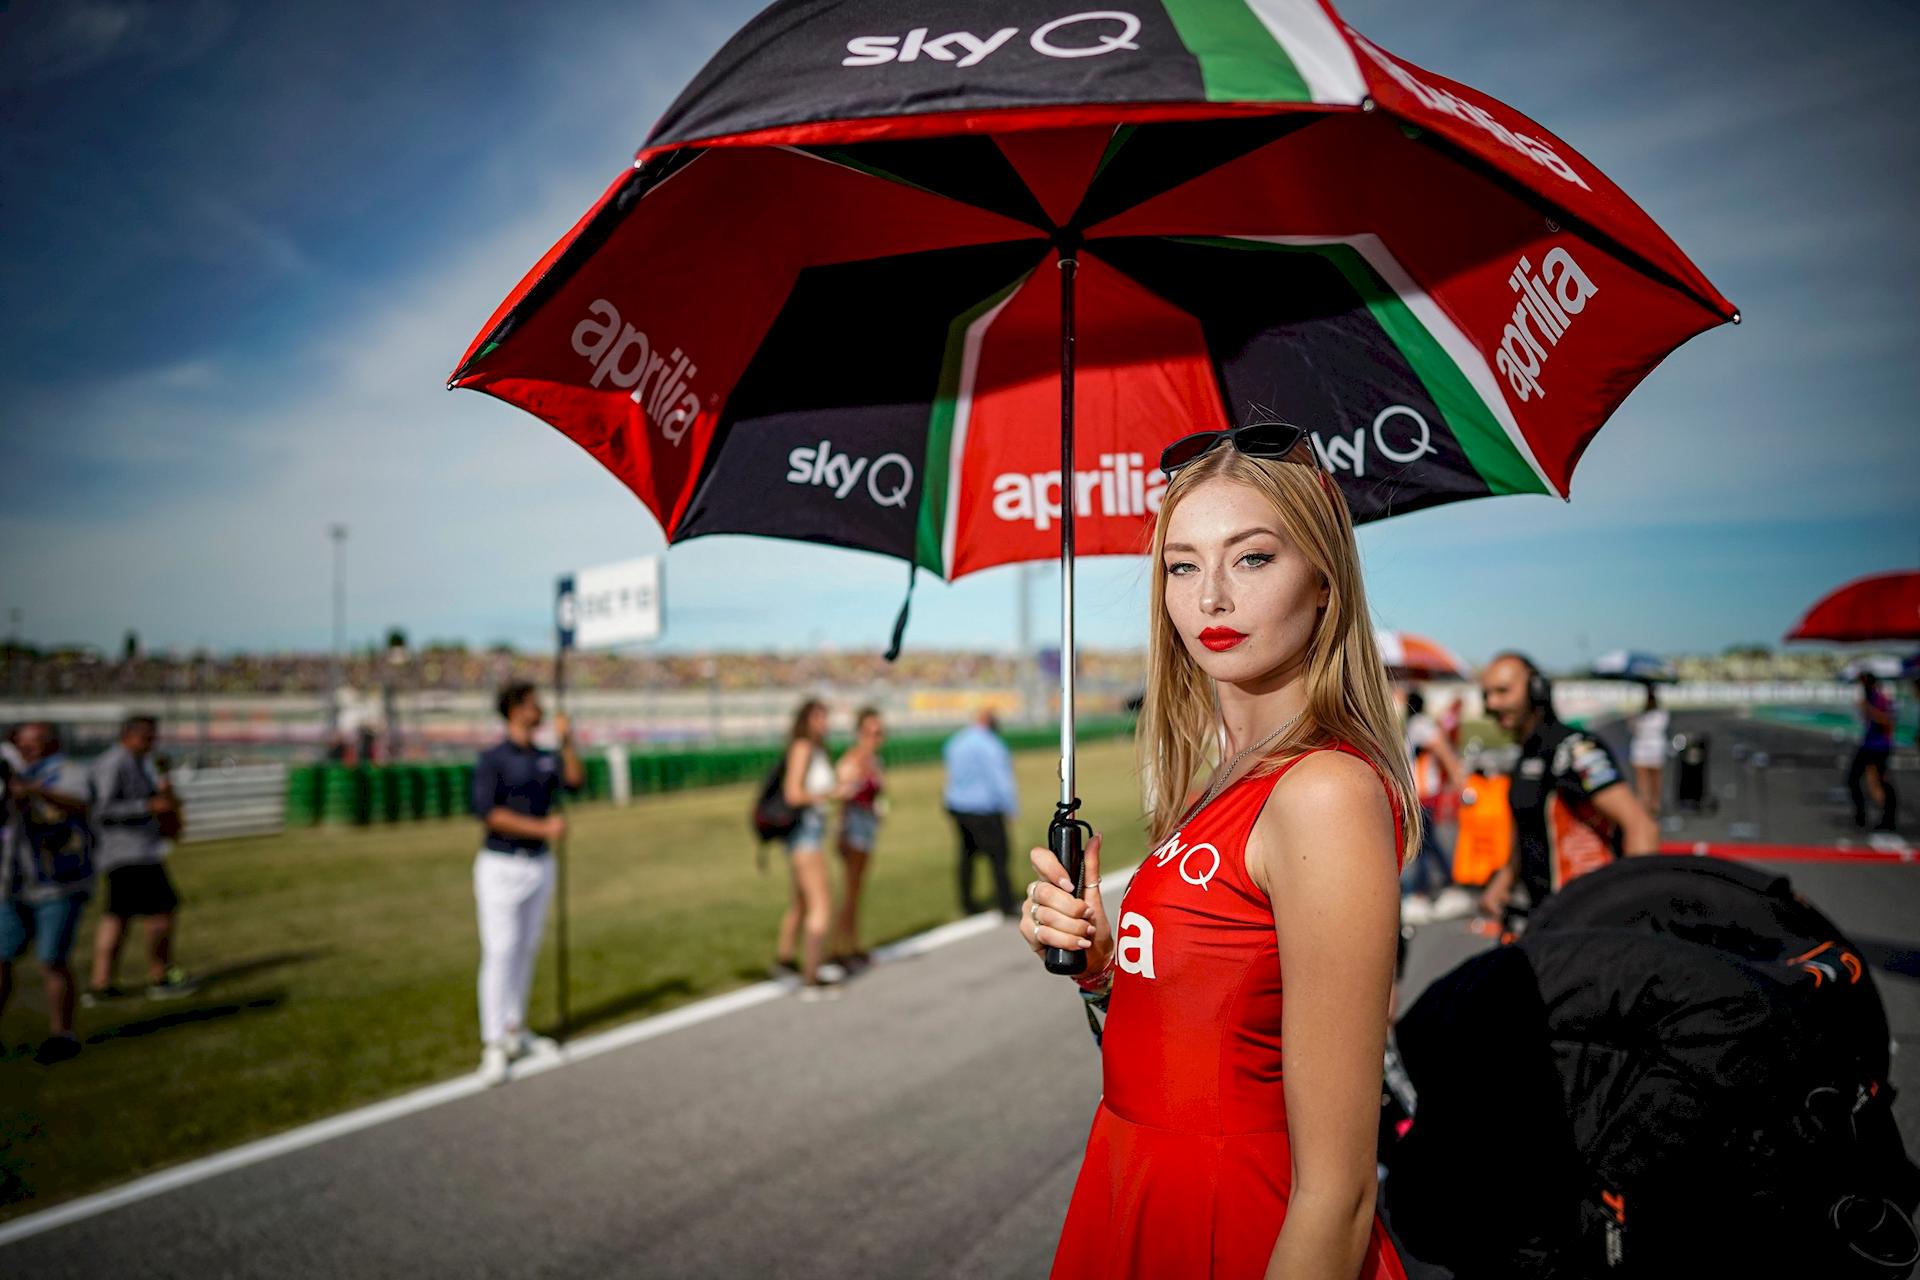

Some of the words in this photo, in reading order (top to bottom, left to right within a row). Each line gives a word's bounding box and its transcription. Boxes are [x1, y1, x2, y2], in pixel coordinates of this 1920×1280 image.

[842, 27, 1020, 68] sky
[1030, 10, 1142, 58] Q
[1496, 247, 1599, 402] aprilia
[571, 299, 700, 448] aprilia
[786, 440, 868, 499] sky
[867, 452, 914, 509] Q
[1310, 427, 1366, 478] ky
[1372, 404, 1439, 463] Q
[1153, 832, 1188, 867] ky
[1179, 842, 1221, 891] Q
